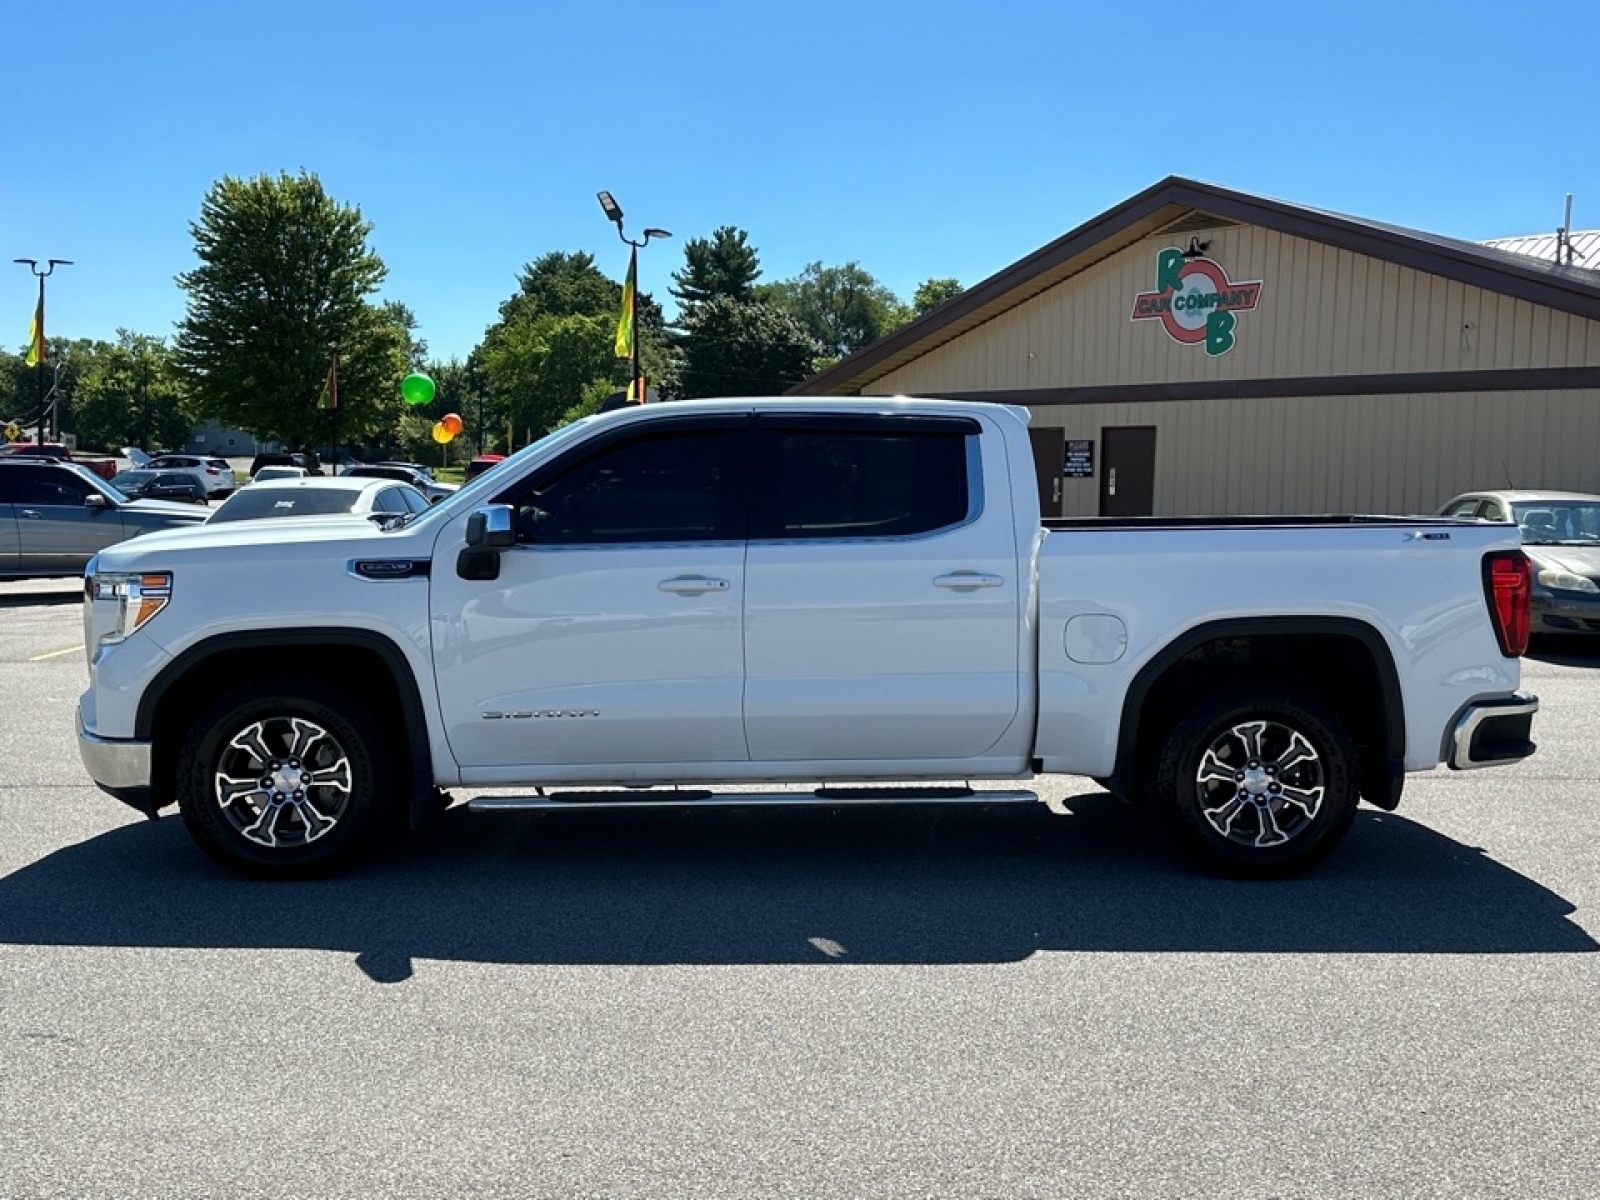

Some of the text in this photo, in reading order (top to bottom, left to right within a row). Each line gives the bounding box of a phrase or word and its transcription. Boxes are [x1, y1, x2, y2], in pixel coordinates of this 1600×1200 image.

[1138, 289, 1253, 313] CAR COMPANY
[1157, 248, 1183, 292] R
[1206, 310, 1235, 355] B
